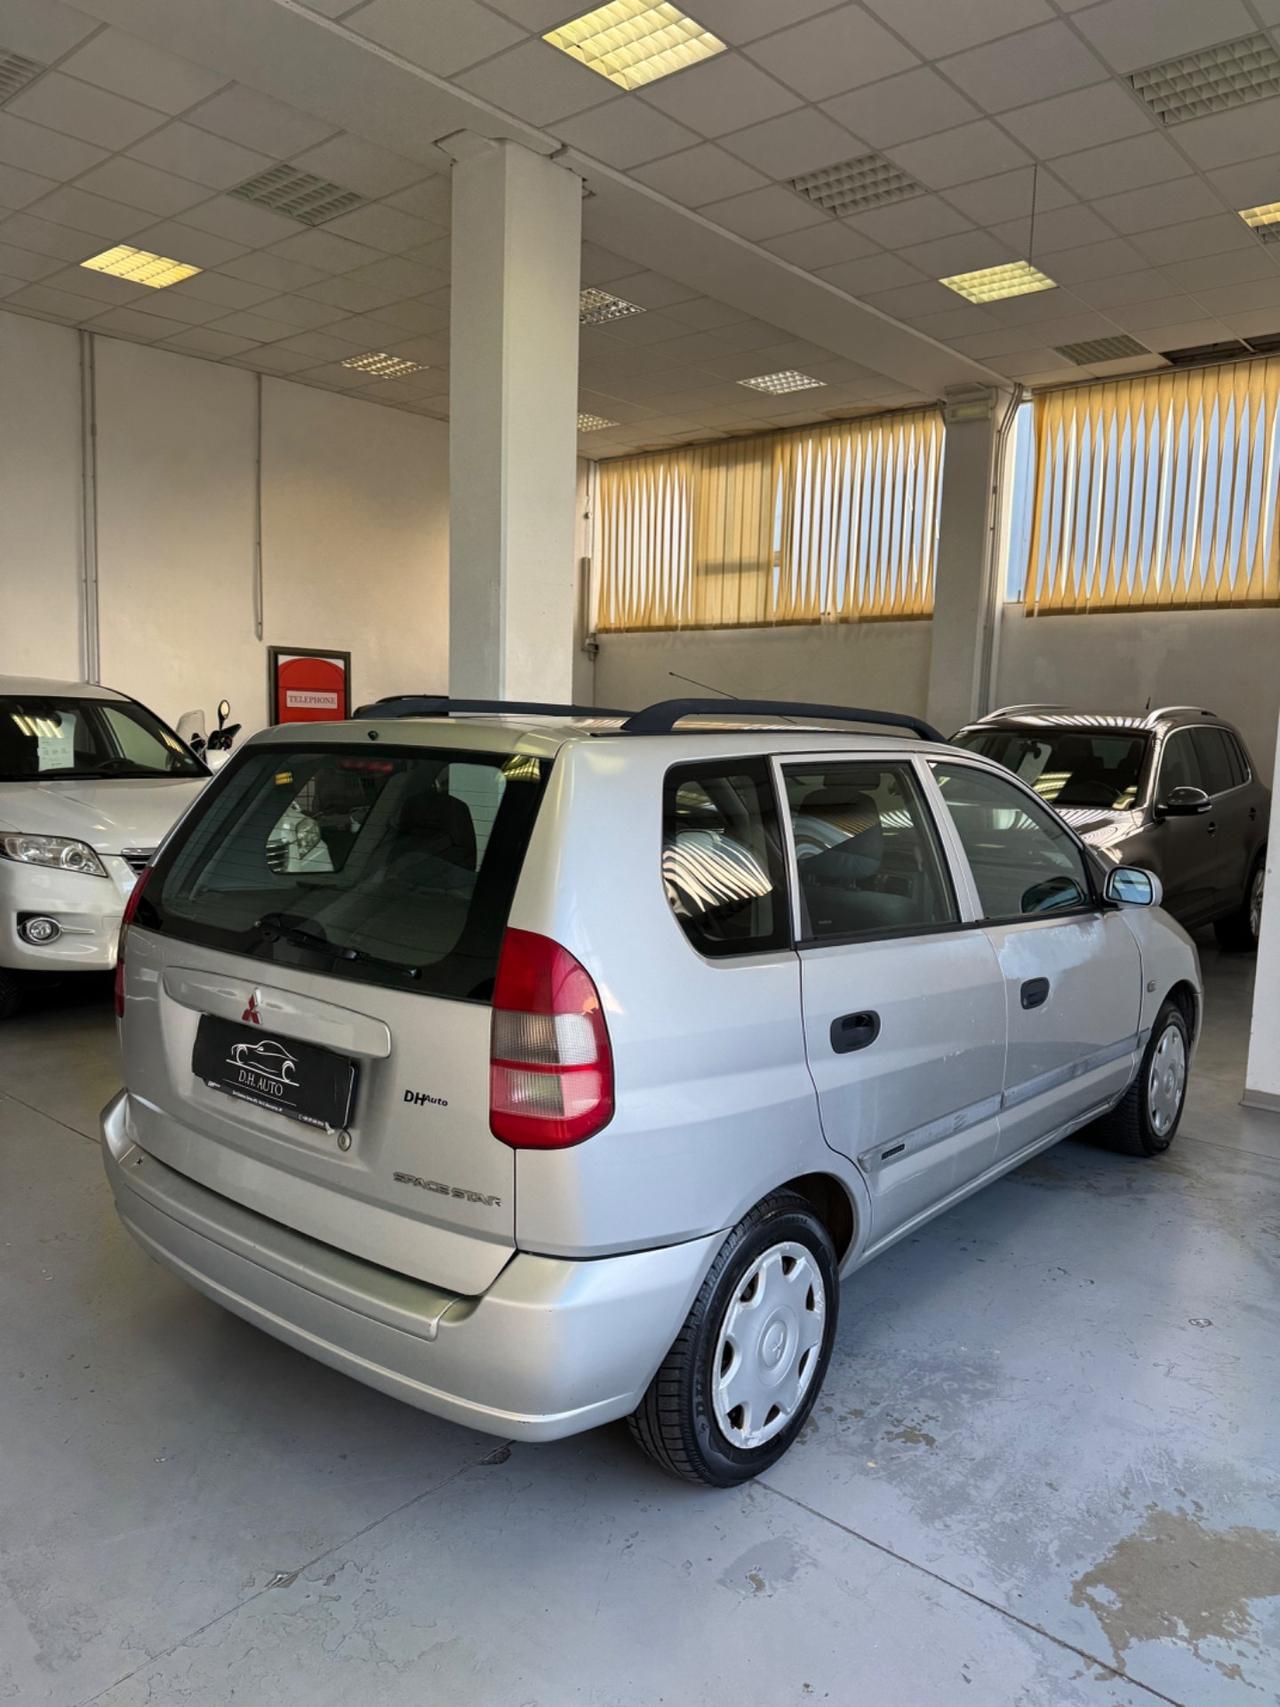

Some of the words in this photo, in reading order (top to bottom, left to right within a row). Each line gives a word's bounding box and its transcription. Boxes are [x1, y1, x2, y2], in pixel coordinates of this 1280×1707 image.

[288, 695, 337, 705] TELEPHONE
[238, 1069, 256, 1087] D.H.
[256, 1076, 283, 1096] AUTO
[393, 1171, 450, 1196] SPACE
[450, 1187, 502, 1207] STAR
